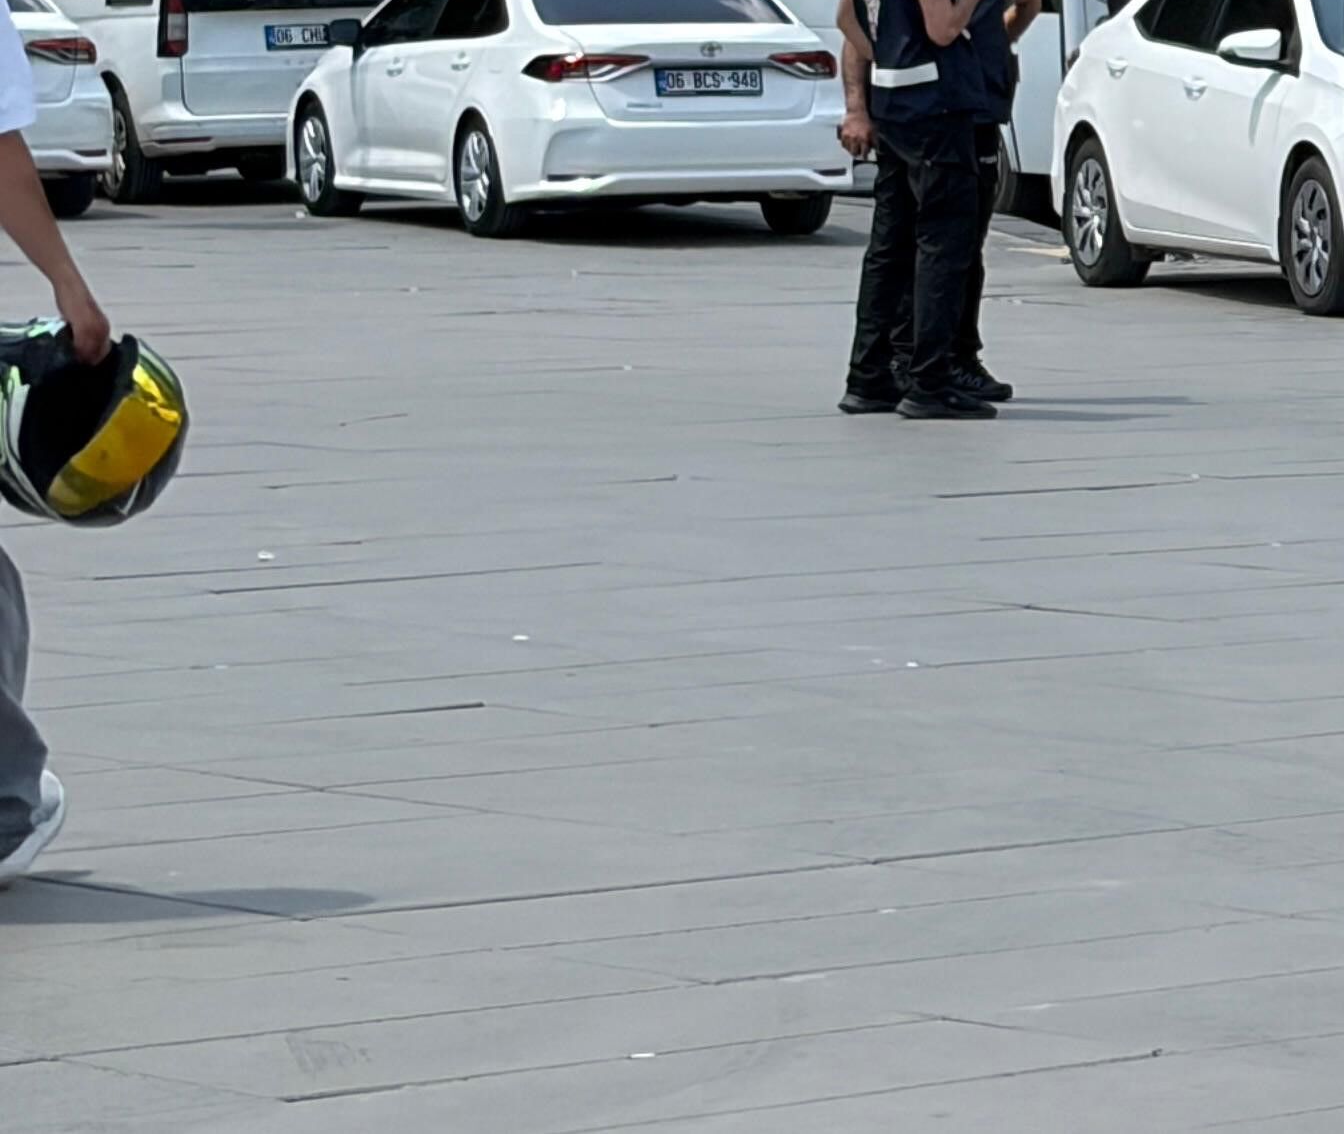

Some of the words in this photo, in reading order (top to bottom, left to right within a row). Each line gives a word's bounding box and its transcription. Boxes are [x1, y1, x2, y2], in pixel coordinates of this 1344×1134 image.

[666, 72, 685, 89] 06
[694, 72, 722, 89] BCS
[732, 72, 758, 89] 948
